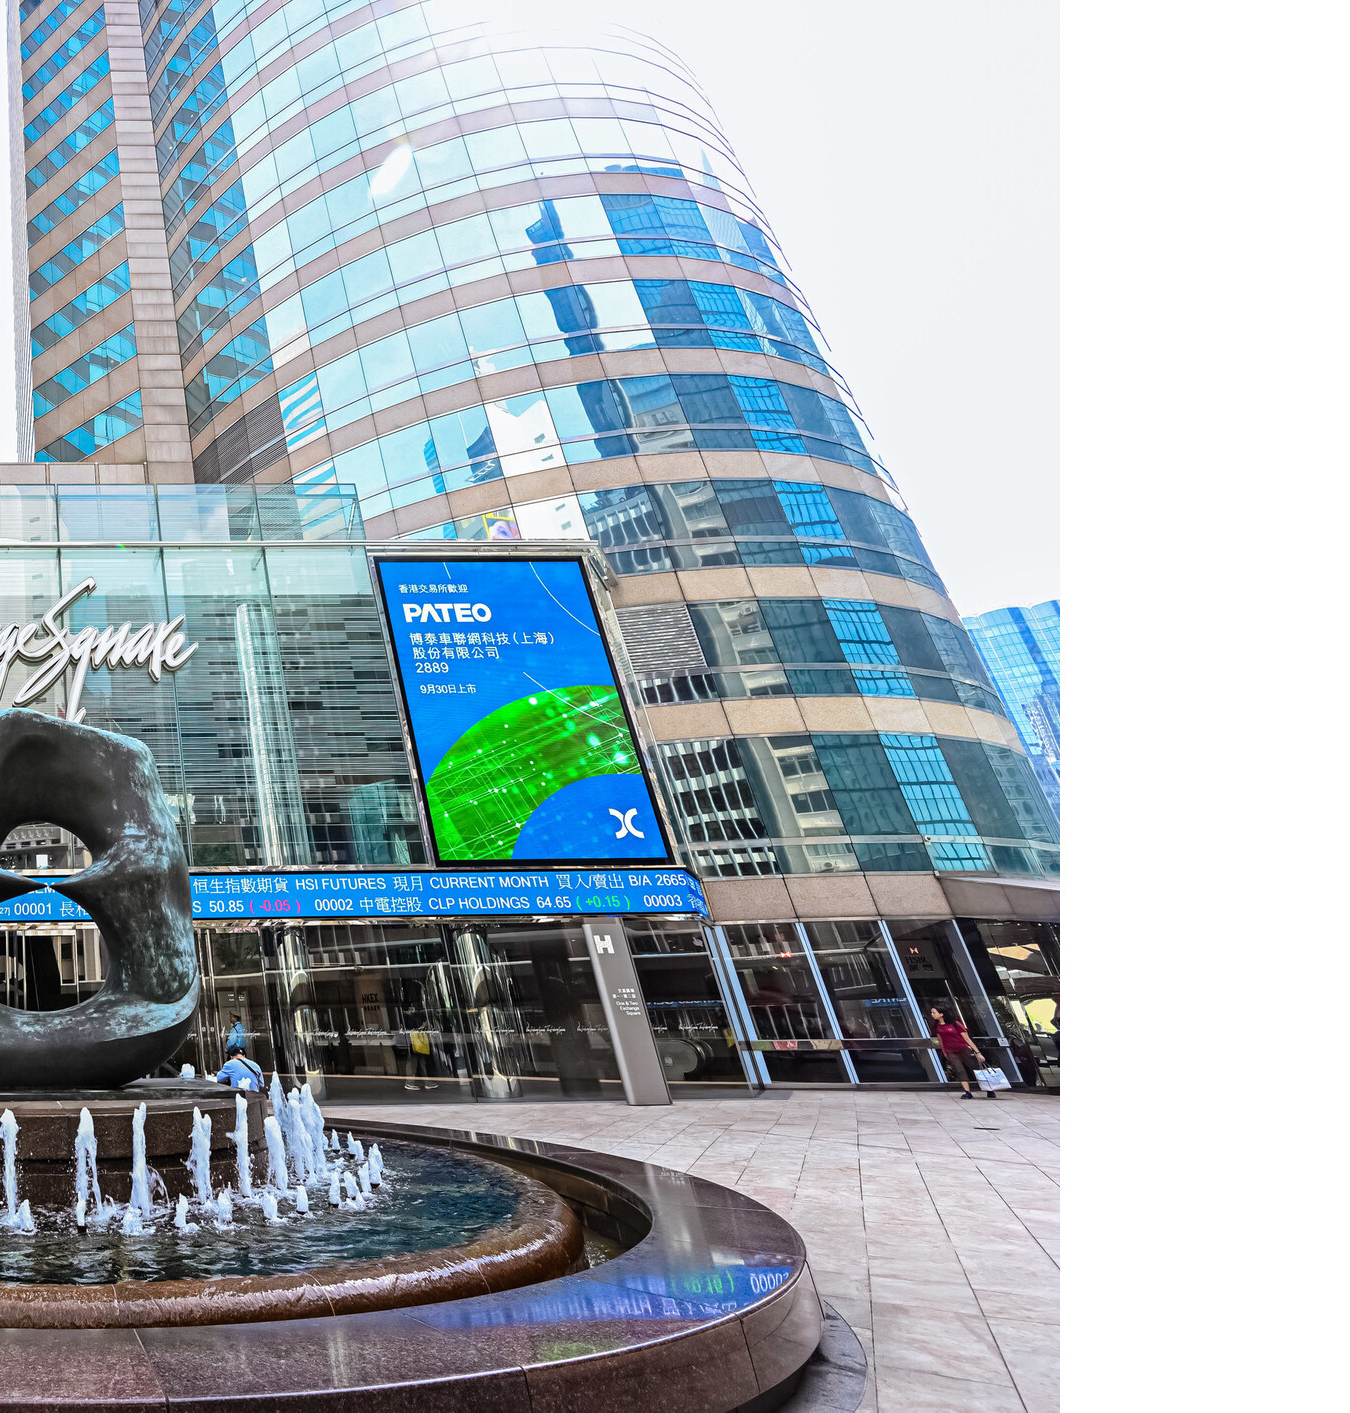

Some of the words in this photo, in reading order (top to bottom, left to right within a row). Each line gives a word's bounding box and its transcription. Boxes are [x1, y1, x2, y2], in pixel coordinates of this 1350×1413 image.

[399, 584, 469, 594] 香港交易所歡迎
[402, 603, 492, 623] PATEO
[12, 576, 199, 724] Square
[413, 646, 500, 660] 股份有限公司
[415, 662, 449, 674] 2889
[420, 683, 477, 695] 9月30日上市
[193, 877, 290, 895] 恒生指數期貨
[295, 879, 318, 891] HSI
[322, 878, 387, 890] FUTURES
[393, 875, 424, 892] 現月
[430, 876, 495, 889] CURRENT
[500, 876, 549, 888] MONTH
[629, 874, 652, 887] B/A
[655, 874, 688, 887] 2665
[13, 902, 52, 915] 00001
[209, 900, 245, 913] 50.85
[314, 899, 354, 911] 00002
[359, 896, 424, 913] 中電控股
[428, 897, 456, 910] CLP
[458, 896, 530, 910] HOLDINGS
[536, 896, 572, 909] 64.65
[643, 894, 683, 907] 00003
